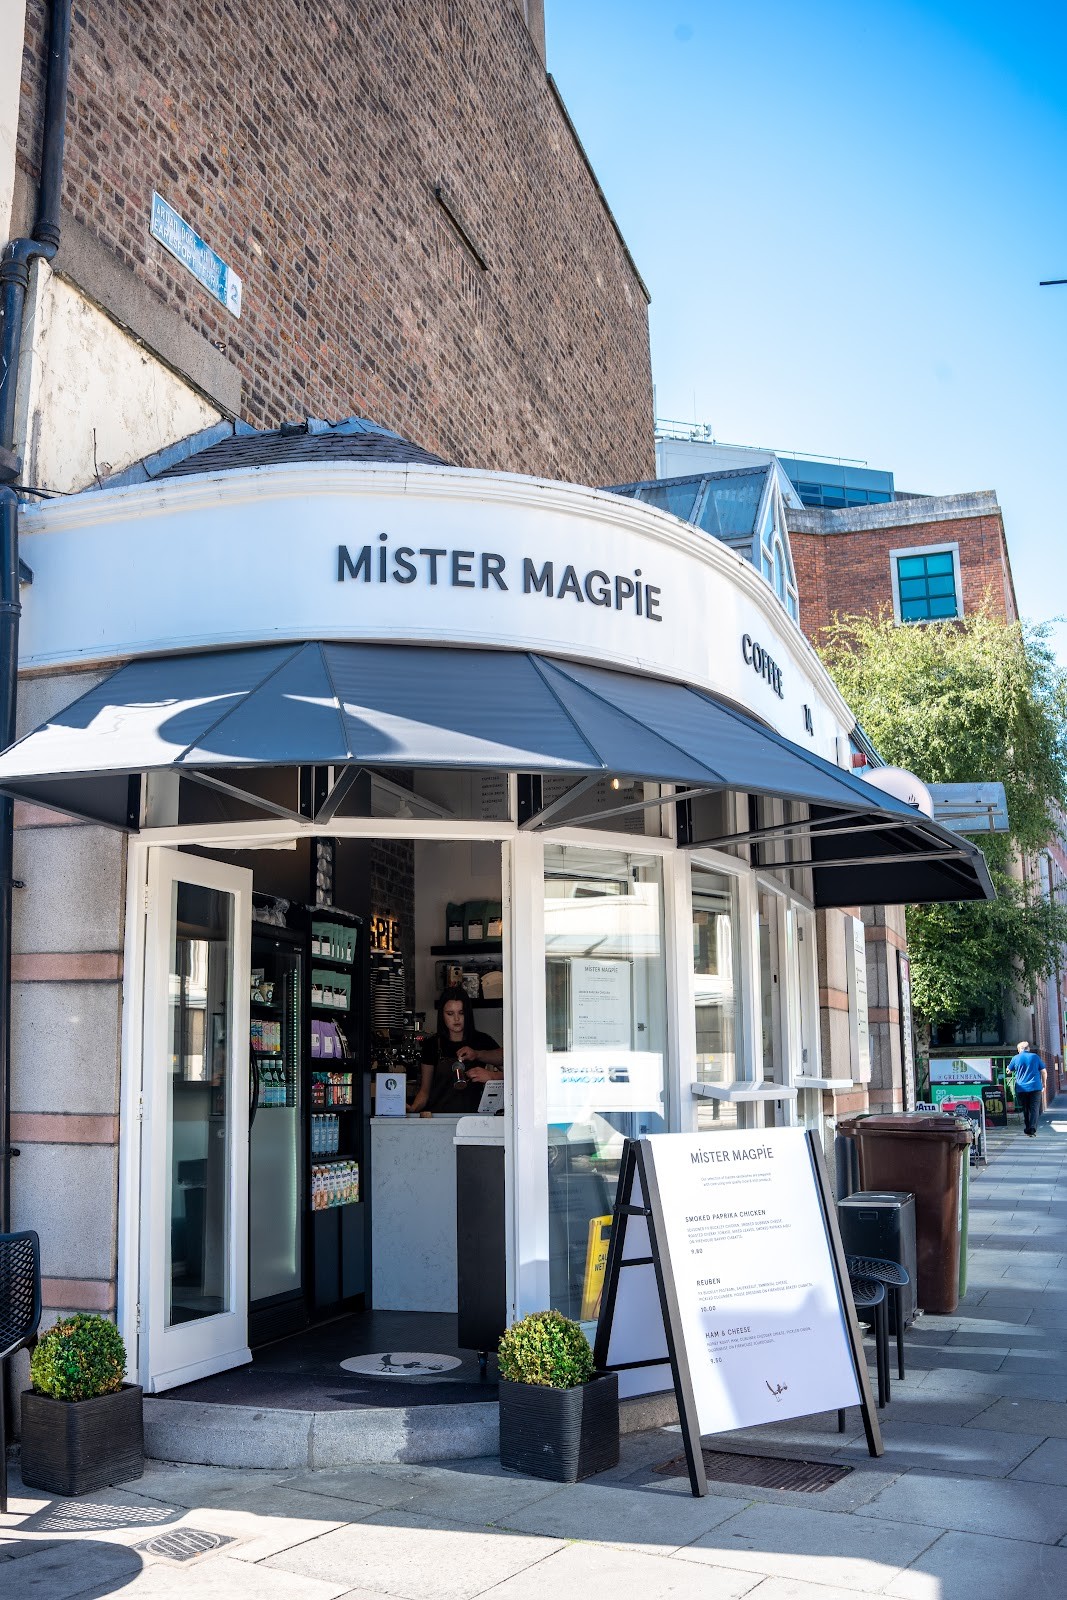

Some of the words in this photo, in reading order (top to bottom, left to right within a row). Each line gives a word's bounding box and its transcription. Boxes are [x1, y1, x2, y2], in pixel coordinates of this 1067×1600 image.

[231, 283, 239, 305] 2
[742, 633, 784, 700] COFFEE
[685, 1214, 711, 1222] SMOKED
[712, 1211, 738, 1220] PAPRIKA
[739, 1209, 766, 1218] CHICKEN
[696, 1277, 721, 1286] REUBEN
[705, 1331, 720, 1339] HAM
[727, 1326, 752, 1335] CHEESE
